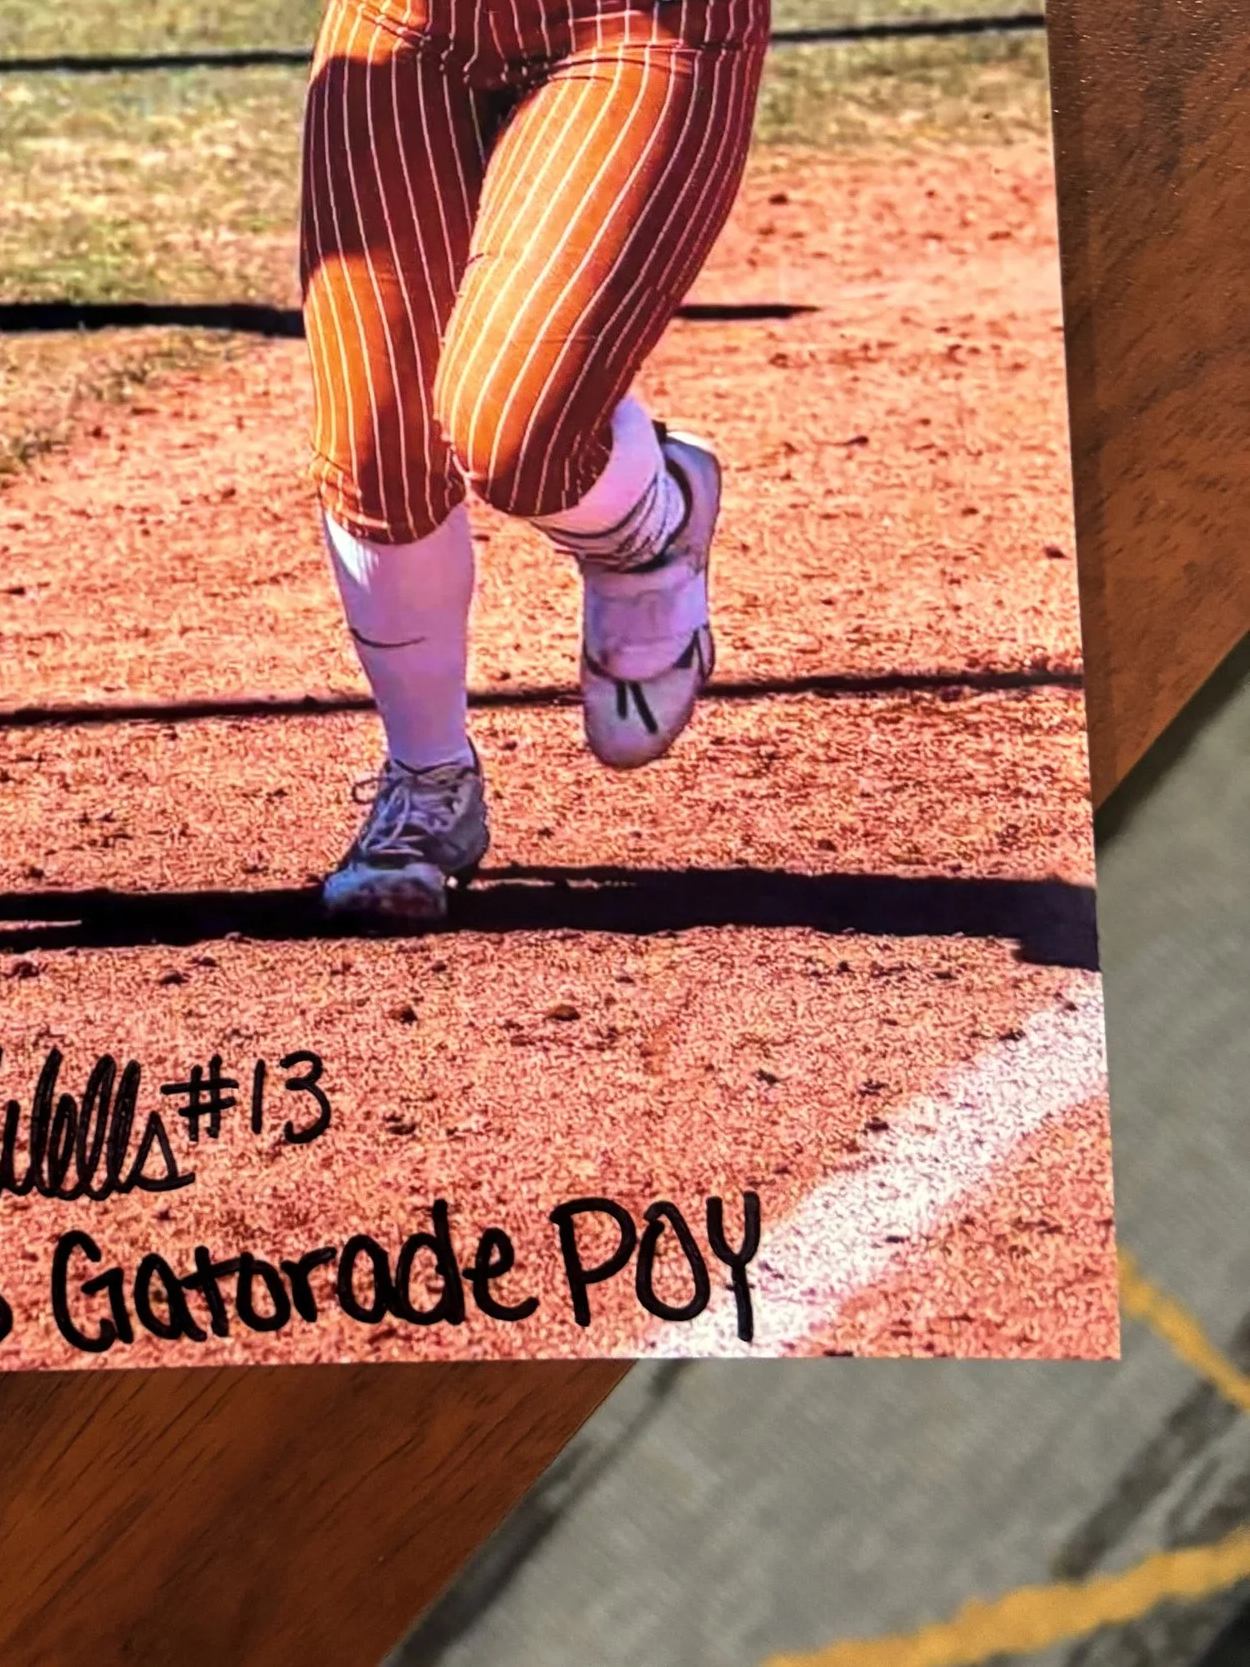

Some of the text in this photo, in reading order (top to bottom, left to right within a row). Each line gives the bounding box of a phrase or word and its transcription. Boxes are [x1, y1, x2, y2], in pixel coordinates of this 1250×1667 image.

[160, 1050, 332, 1144] #13
[51, 1199, 540, 1353] Gatorade
[549, 1192, 761, 1343] POY
